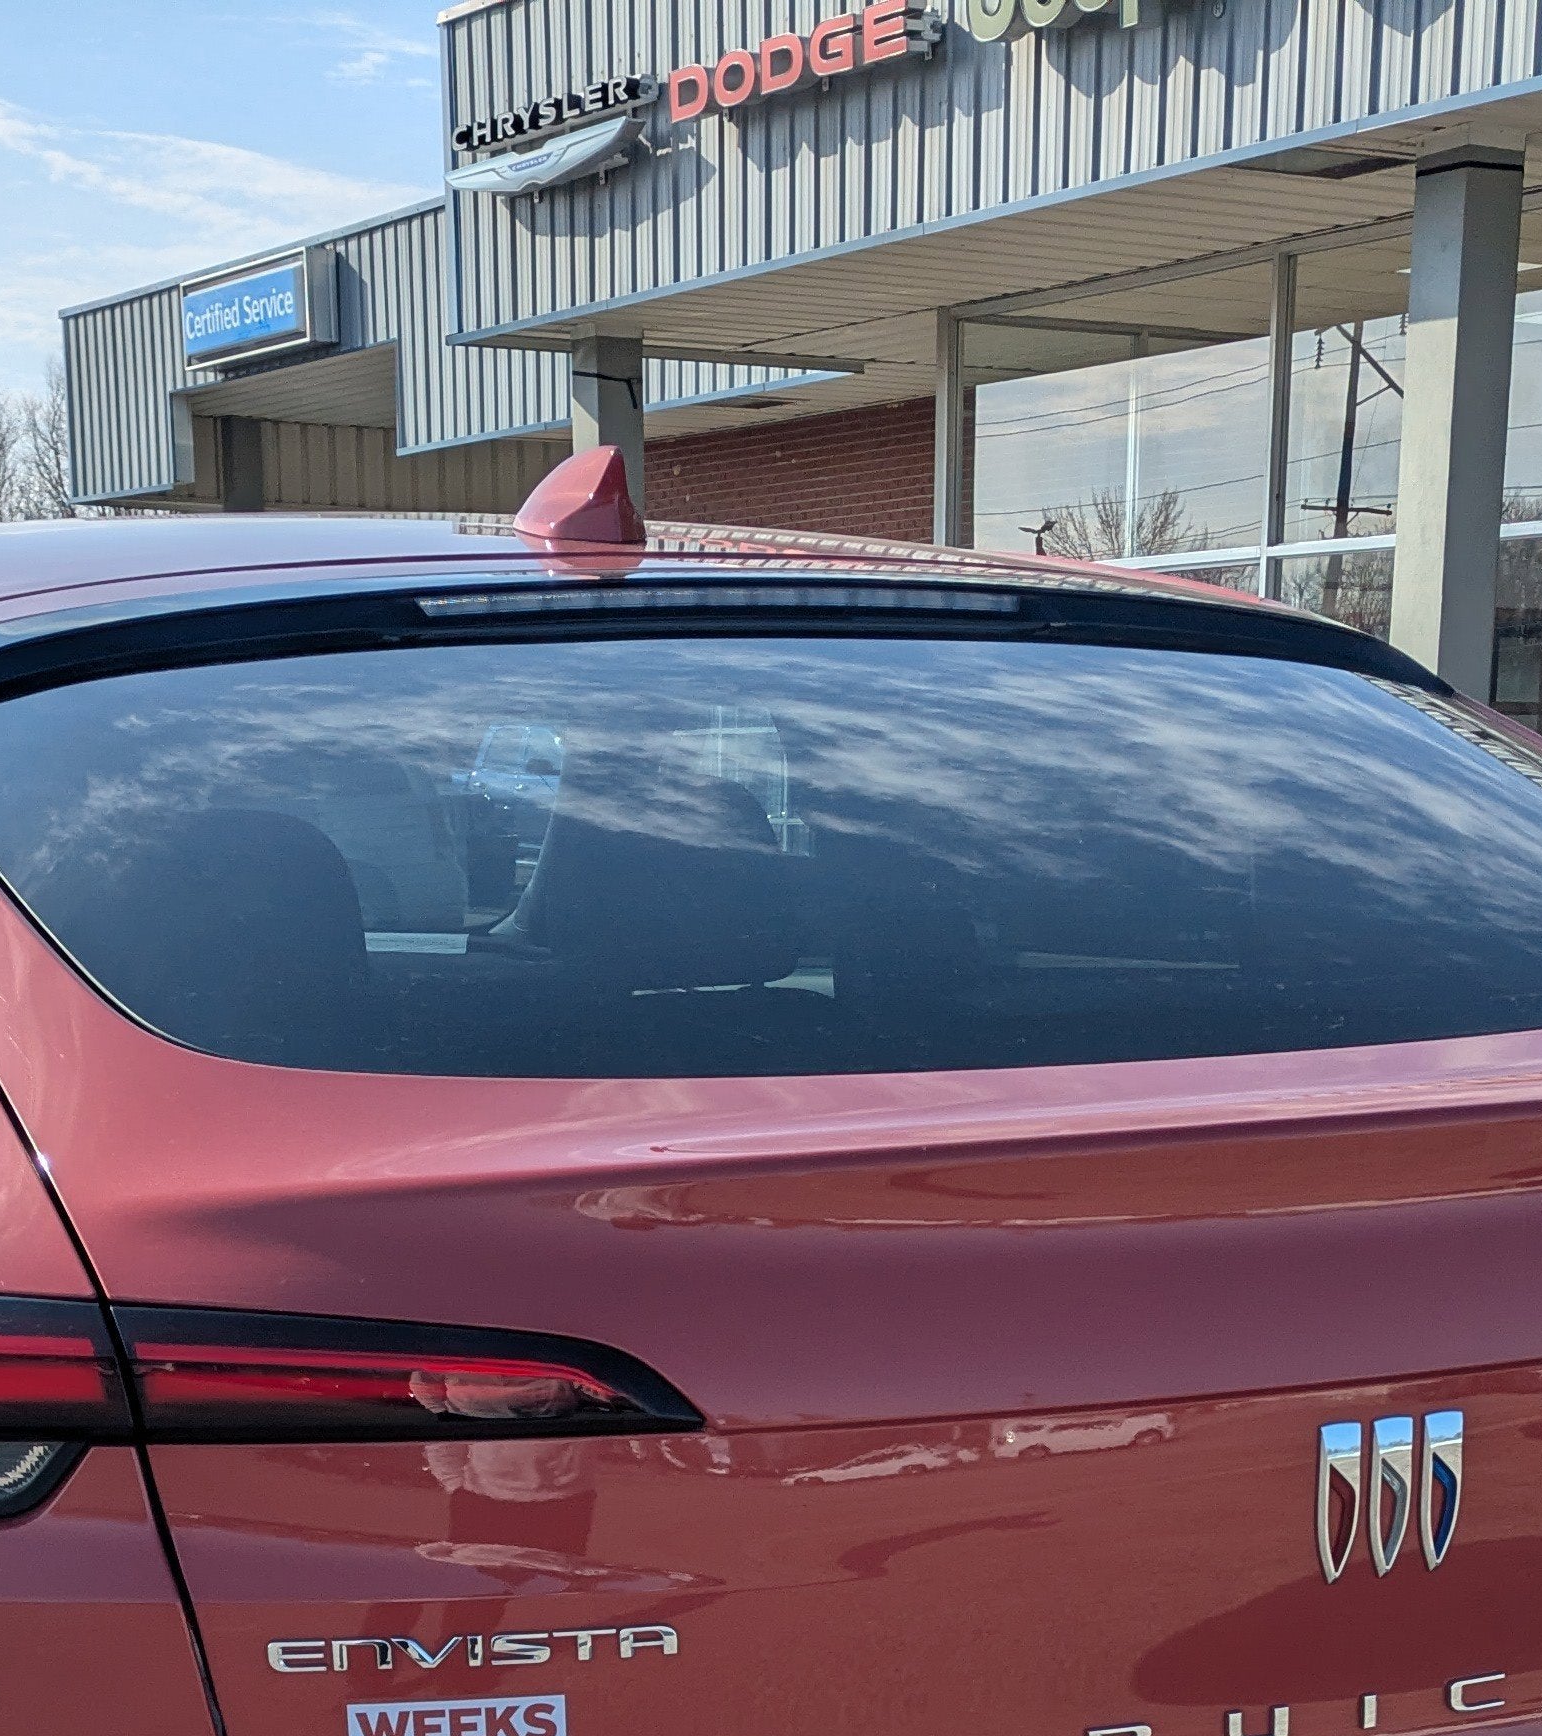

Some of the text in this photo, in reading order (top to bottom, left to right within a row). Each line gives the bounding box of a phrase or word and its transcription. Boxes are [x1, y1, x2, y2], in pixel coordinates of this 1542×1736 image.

[670, 0, 909, 123] DODGE
[452, 76, 628, 151] CHRYSLER
[186, 288, 294, 340] Certified Service
[267, 1624, 679, 1673] ENVISTA
